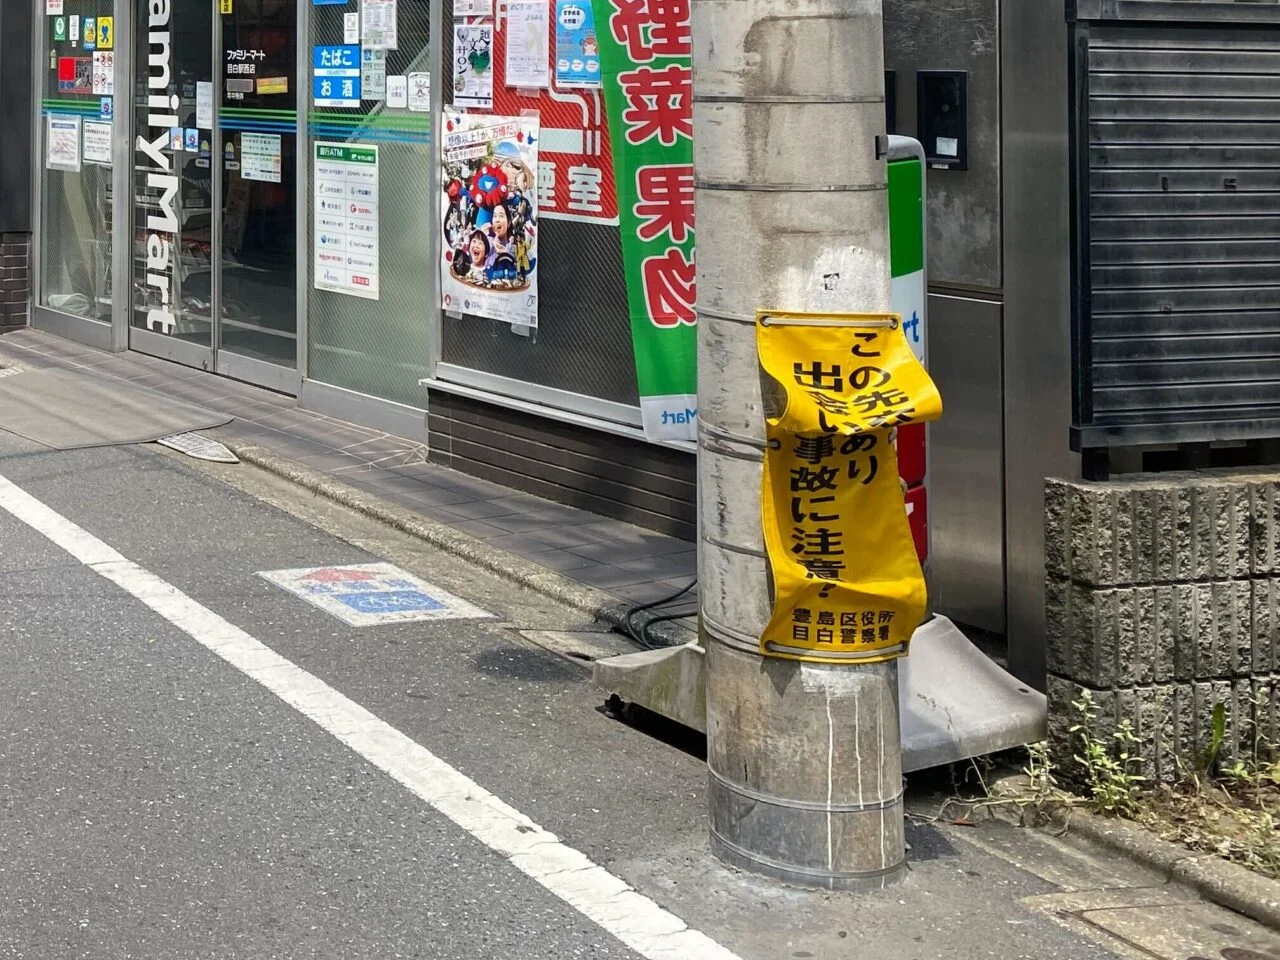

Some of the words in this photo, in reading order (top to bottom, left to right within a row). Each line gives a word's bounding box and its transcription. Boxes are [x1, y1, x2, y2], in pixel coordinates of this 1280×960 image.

[227, 49, 266, 61] ファミリーマート
[321, 49, 352, 66] たばこ
[227, 63, 256, 74] 目白駅西店
[321, 79, 353, 97] お酒
[792, 607, 896, 627] 豊島区役所
[792, 624, 890, 644] 目白警察署
